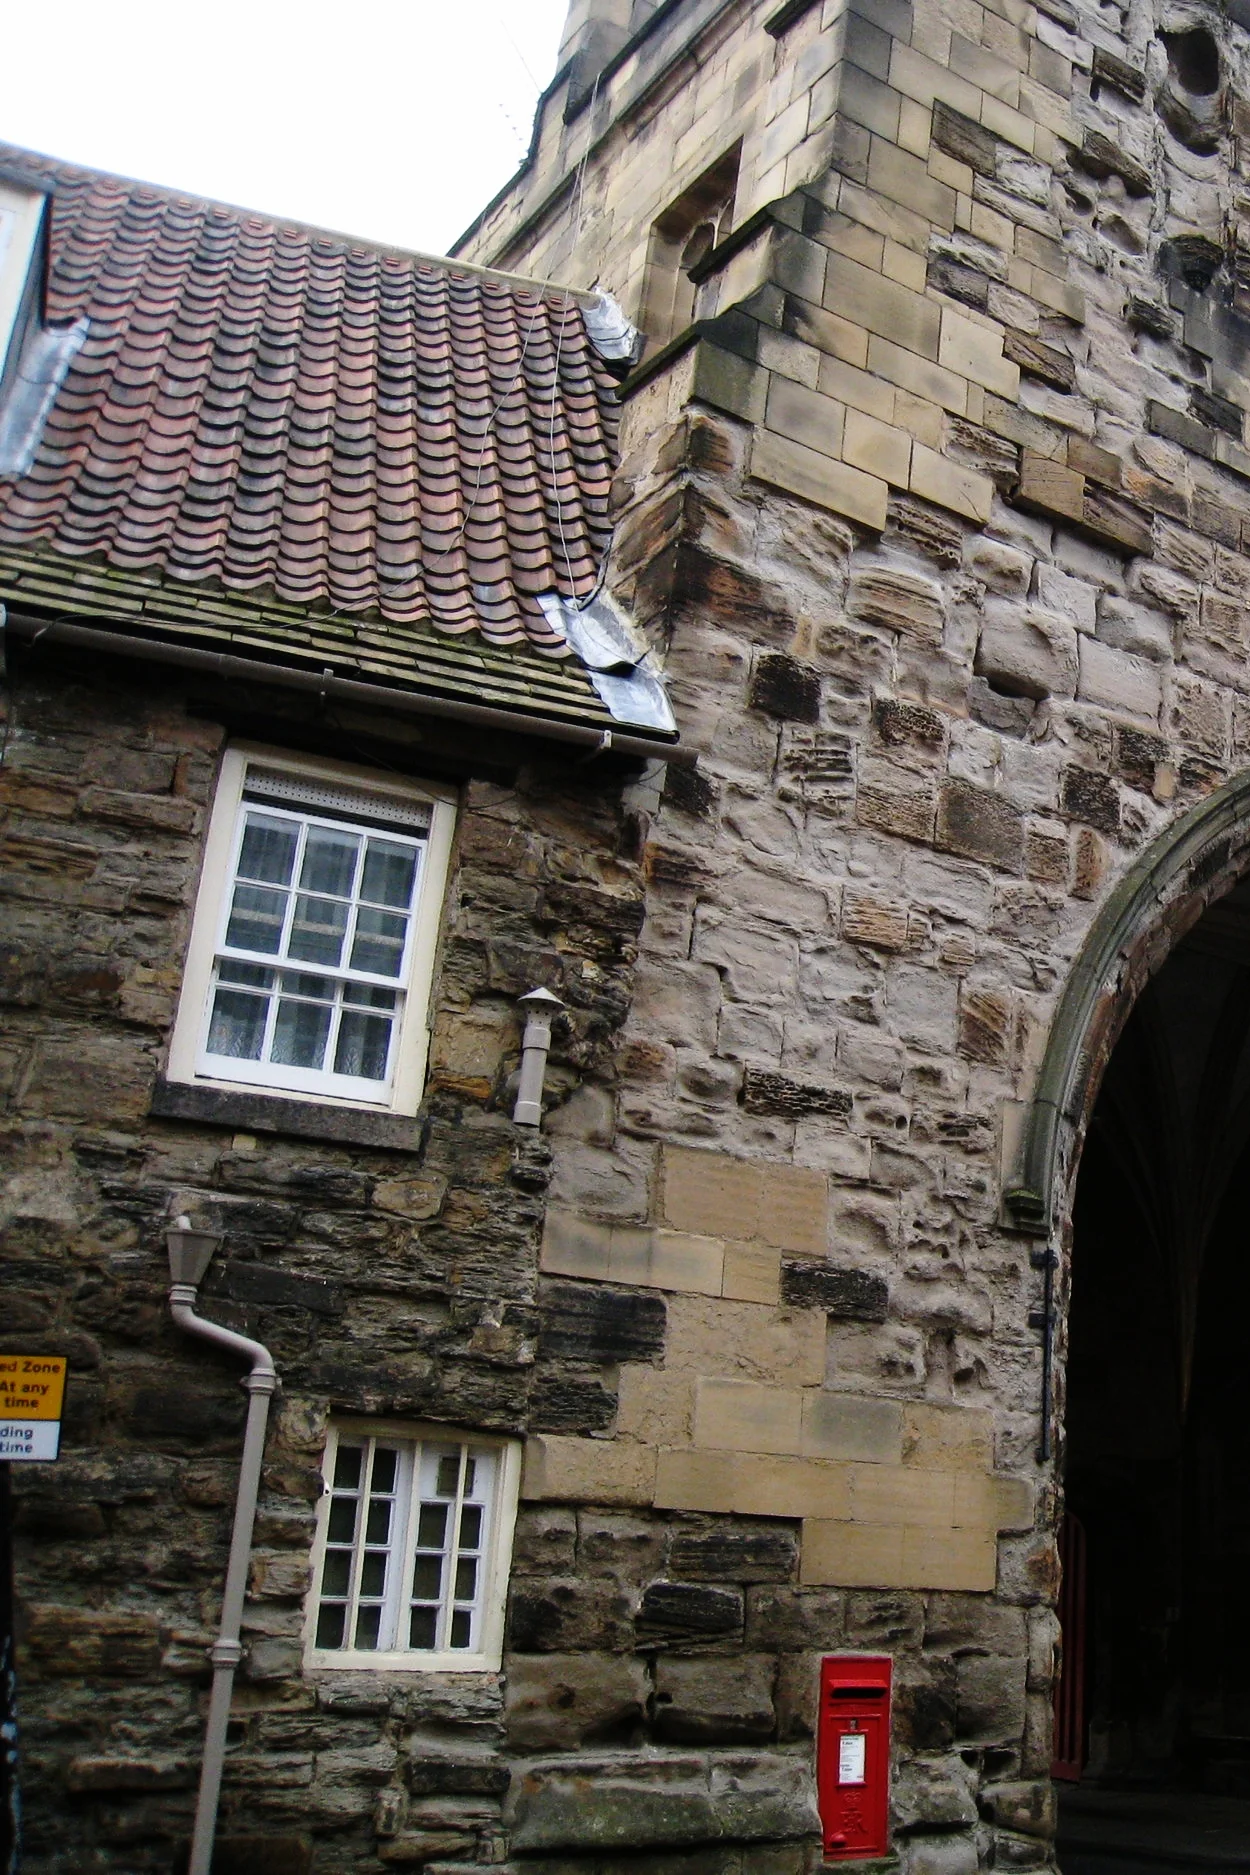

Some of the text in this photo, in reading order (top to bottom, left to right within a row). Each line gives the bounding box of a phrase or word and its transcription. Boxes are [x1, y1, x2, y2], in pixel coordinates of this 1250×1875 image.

[22, 1361, 60, 1373] Zone
[0, 1381, 50, 1396] At any
[5, 1397, 40, 1409] time
[0, 1442, 33, 1454] time
